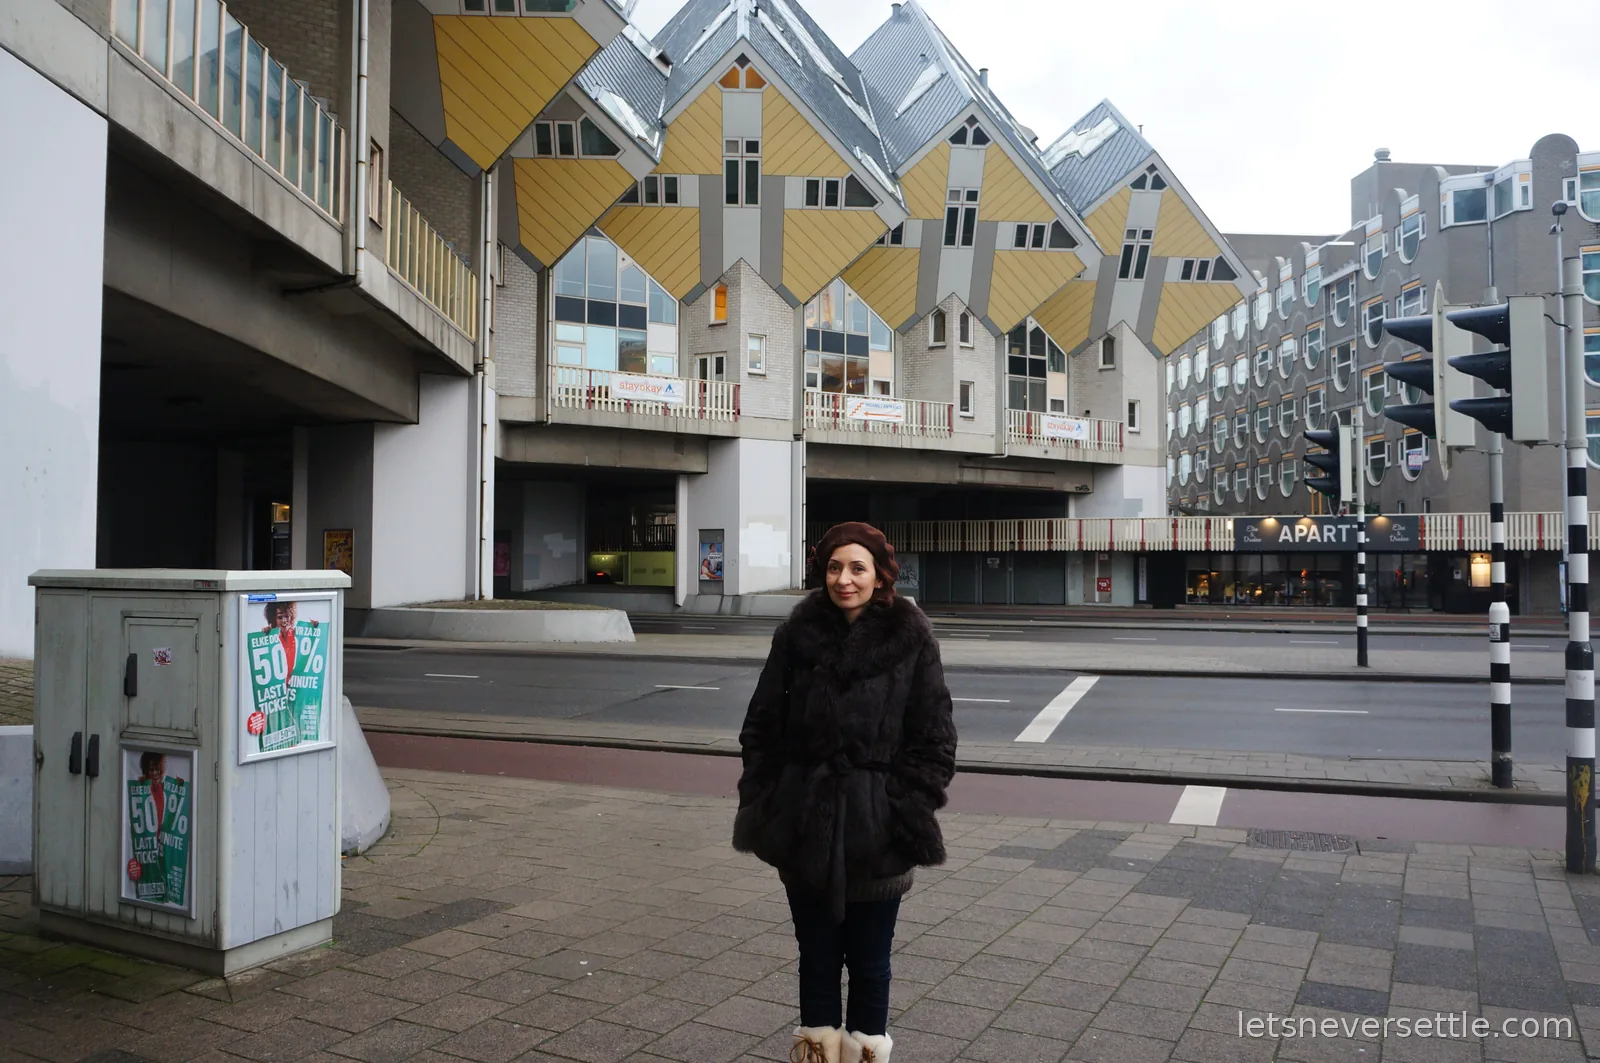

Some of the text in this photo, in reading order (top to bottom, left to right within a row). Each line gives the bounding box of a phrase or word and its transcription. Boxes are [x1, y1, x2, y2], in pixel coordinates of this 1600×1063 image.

[1278, 524, 1370, 543] APART.
[251, 636, 269, 648] ELKE
[303, 627, 312, 636] ZA
[257, 684, 282, 703] LAST
